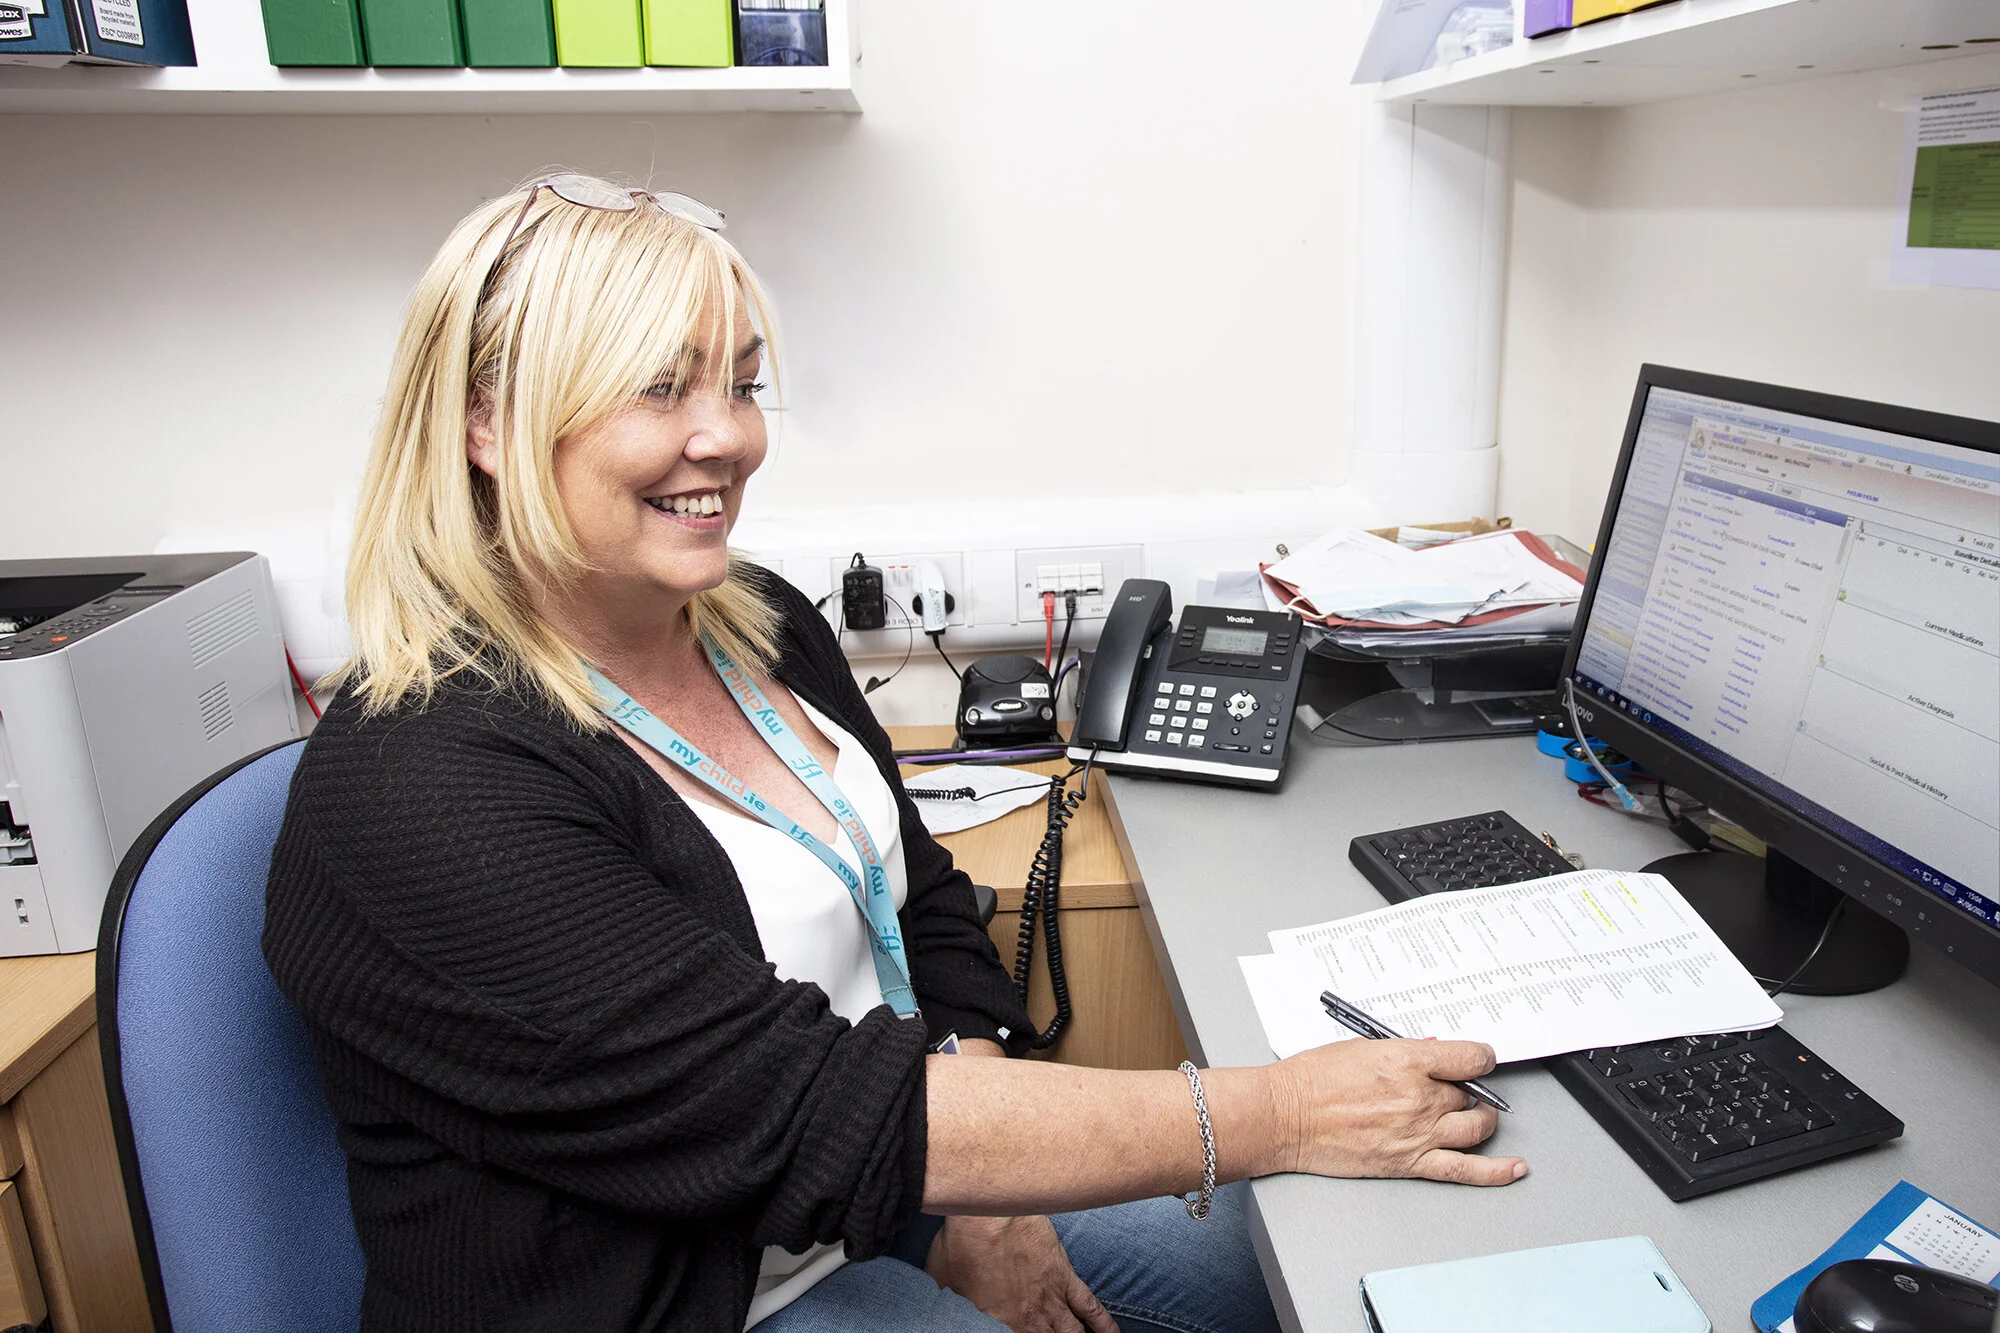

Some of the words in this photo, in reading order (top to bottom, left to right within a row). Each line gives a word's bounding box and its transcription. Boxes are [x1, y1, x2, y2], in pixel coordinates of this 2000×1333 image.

[1954, 549, 1979, 562] Baseline
[1226, 615, 1255, 624] Yealink
[1925, 621, 1948, 634] Current
[1948, 629, 1984, 647] Medications
[1561, 693, 1594, 722] Lovo
[1907, 694, 1927, 707] Active
[1926, 702, 1955, 719] Diagnosis
[668, 739, 767, 812] mychild.ie
[1869, 756, 1885, 769] Social
[1891, 767, 1904, 778] Past
[1905, 773, 1926, 789] Medical
[1926, 785, 1949, 800] History
[833, 799, 885, 896] mychild.ie
[1706, 1133, 1719, 1145] Enter
[1943, 1214, 1983, 1238] JANUARY
